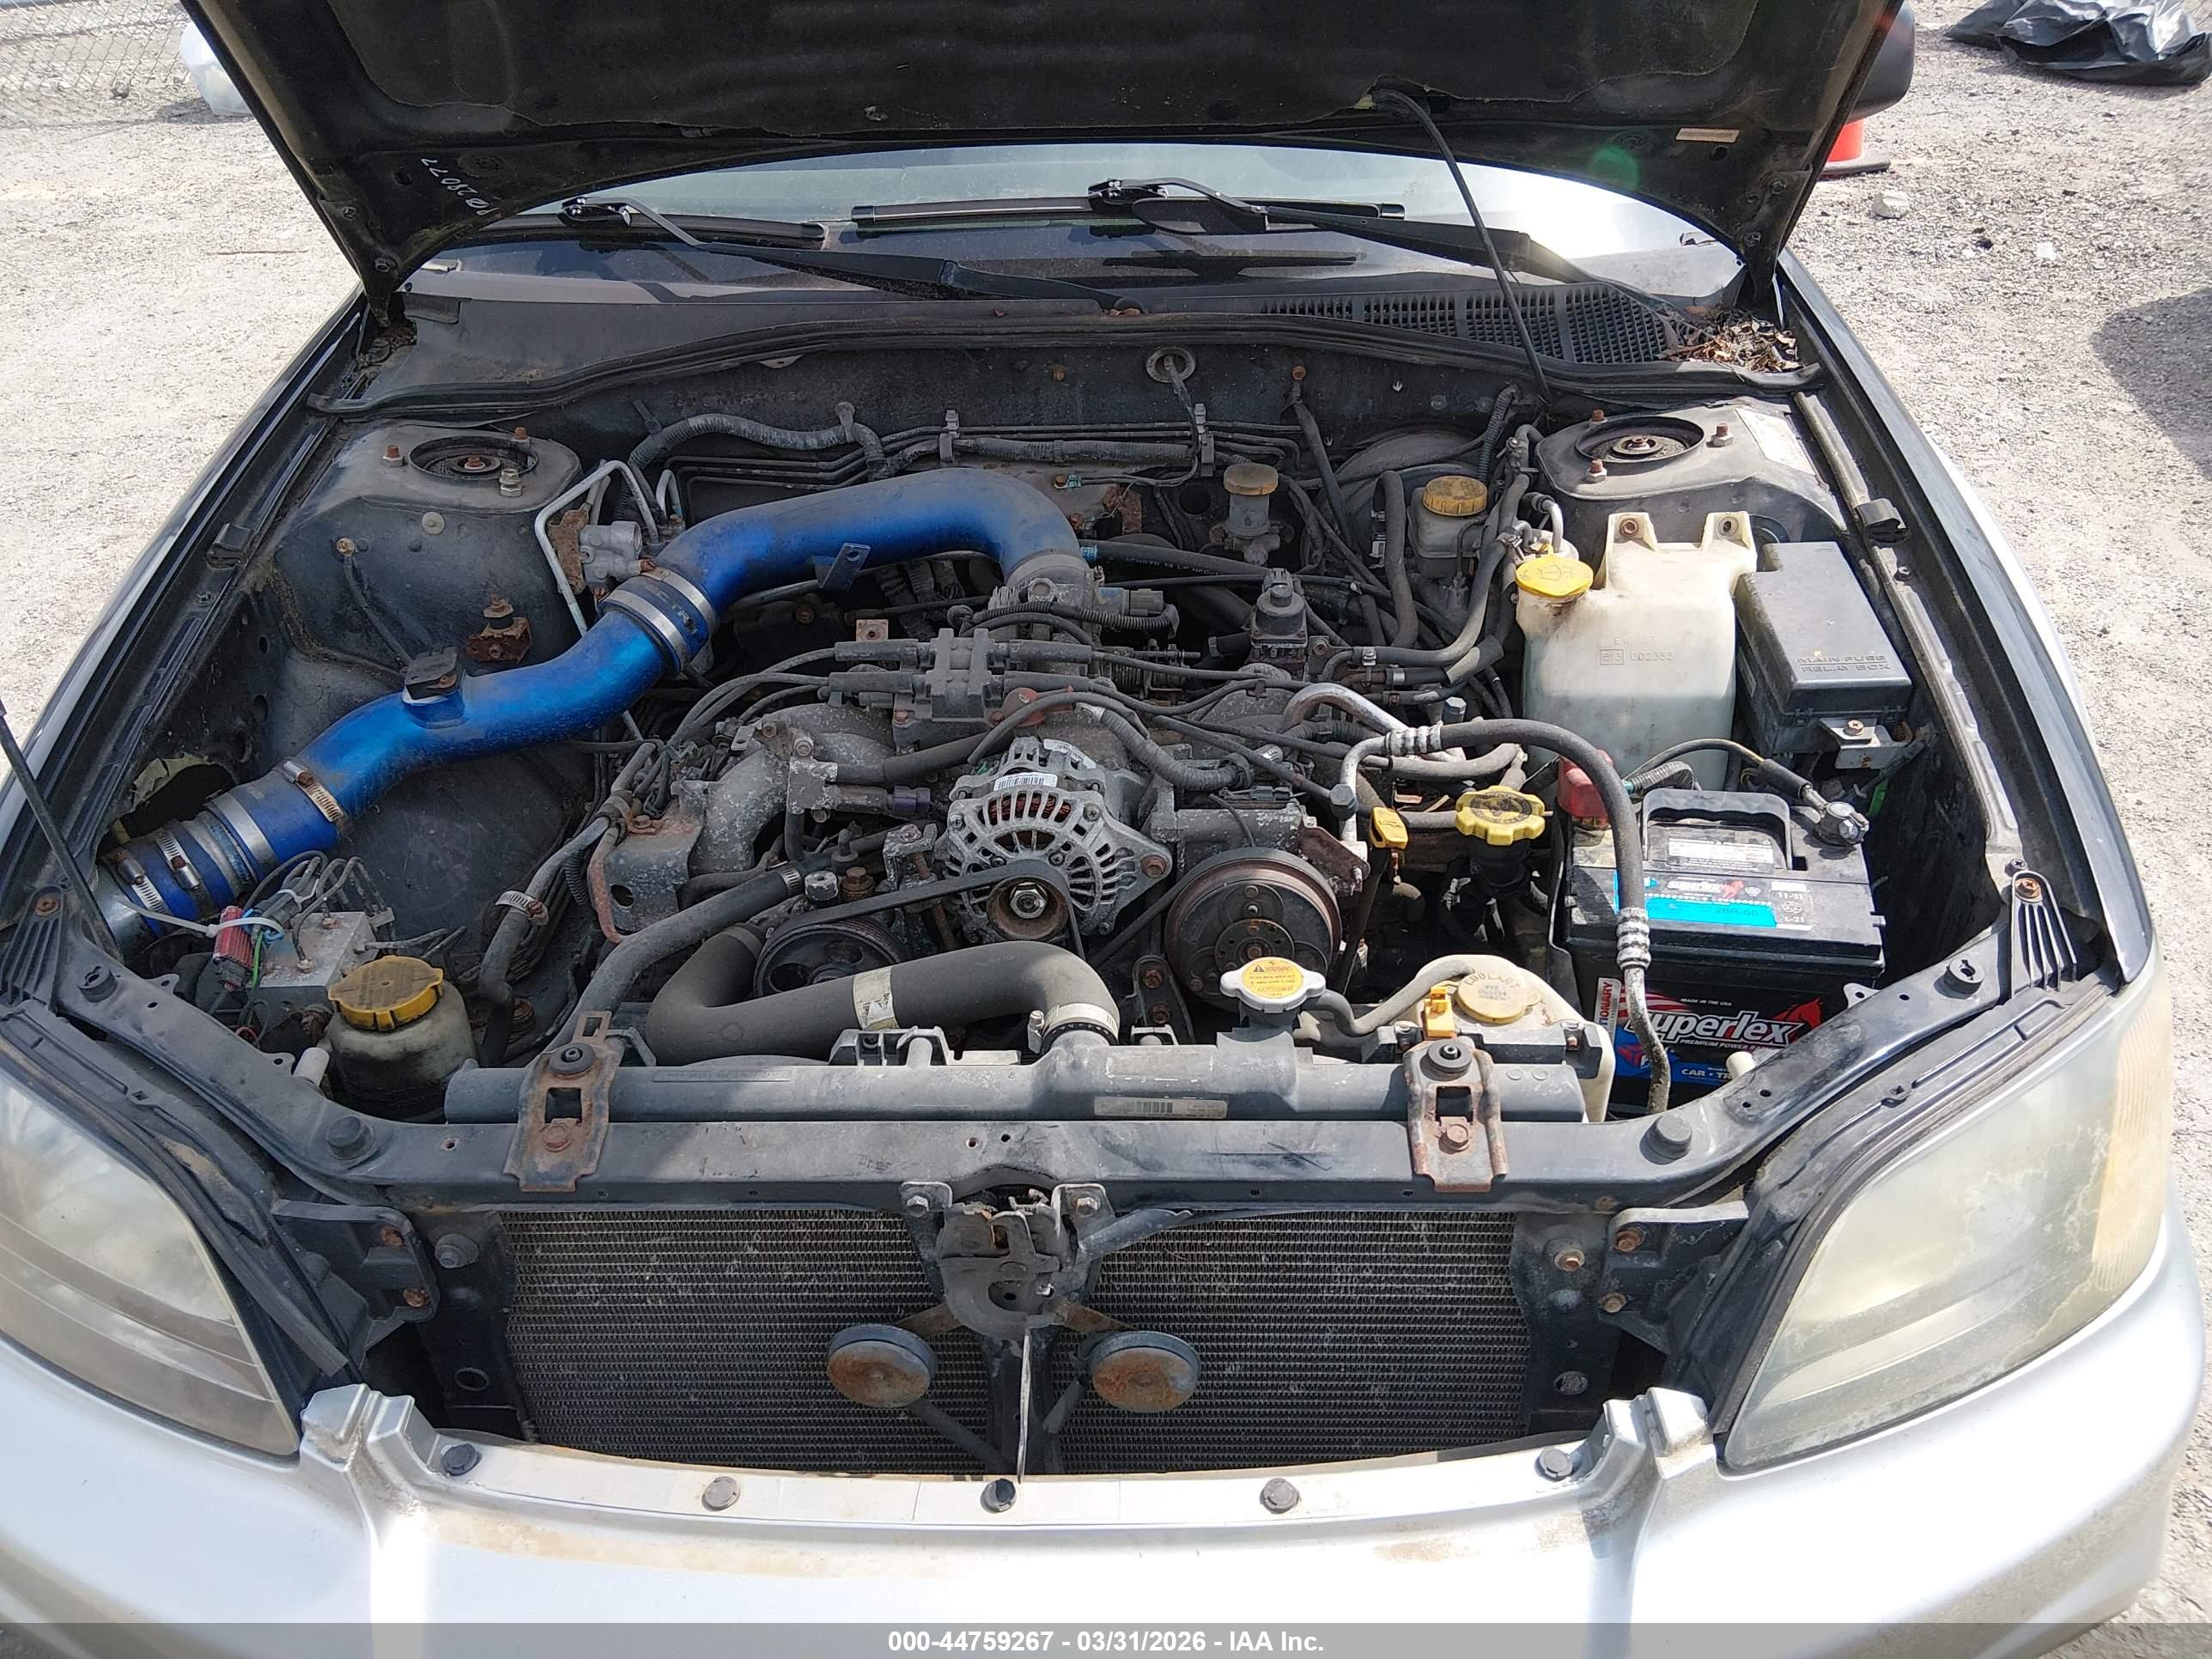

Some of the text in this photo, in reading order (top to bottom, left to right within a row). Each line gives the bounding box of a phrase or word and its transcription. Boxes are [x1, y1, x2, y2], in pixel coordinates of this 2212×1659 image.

[1598, 981, 1613, 1026] TIONARY
[1628, 1011, 1794, 1045] uperlex
[1680, 1038, 1719, 1047] PREMIUM
[1681, 1068, 1705, 1077] CAR
